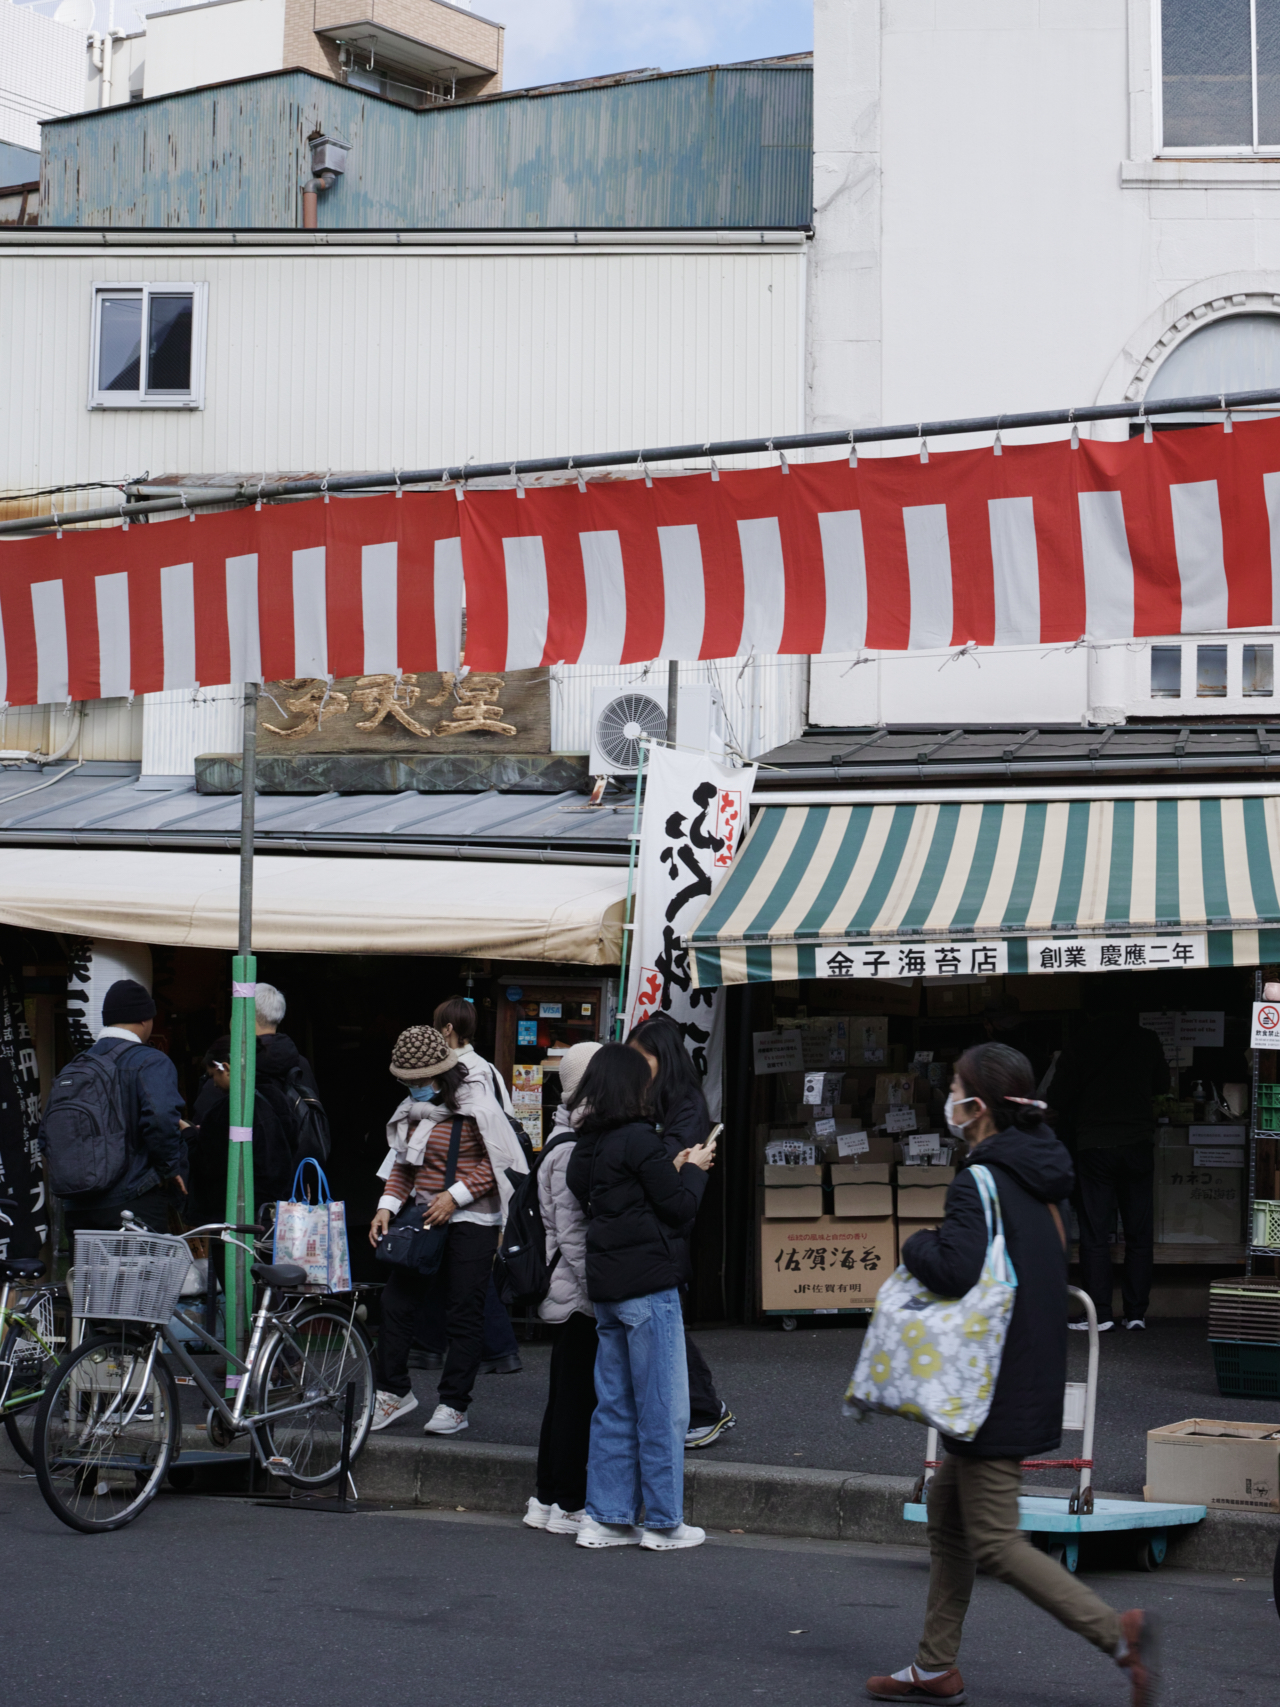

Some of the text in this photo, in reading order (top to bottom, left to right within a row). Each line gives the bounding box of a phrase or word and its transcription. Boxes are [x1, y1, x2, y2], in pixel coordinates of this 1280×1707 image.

[825, 945, 999, 978] 金子海苔店
[1039, 942, 1196, 969] 創業 慶應二年
[542, 1006, 560, 1014] VISA
[1255, 1029, 1280, 1037] 飲食禁止
[787, 1233, 868, 1242] 伝統の風味と自然の香り
[774, 1245, 882, 1272] 佐賀海苔
